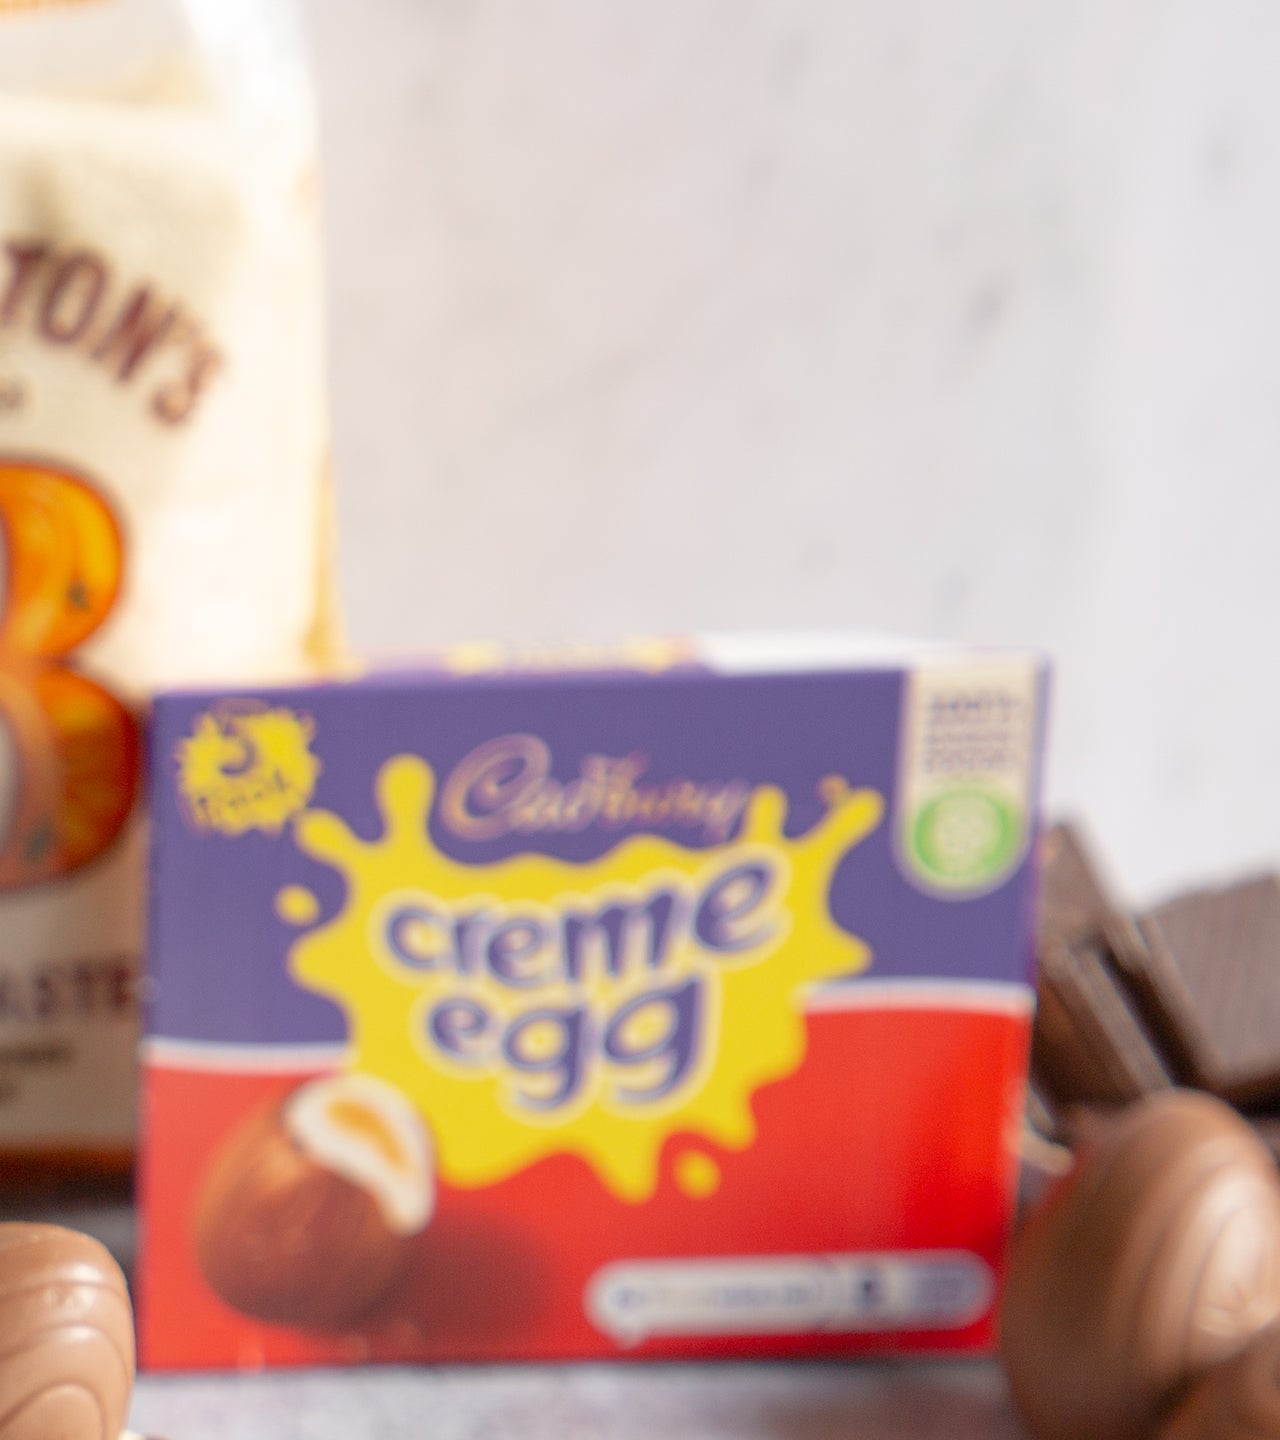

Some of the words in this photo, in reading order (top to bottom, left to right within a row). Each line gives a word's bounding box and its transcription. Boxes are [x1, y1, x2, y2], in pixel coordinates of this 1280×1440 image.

[443, 733, 746, 842] Cadbury
[385, 862, 783, 987] creme
[427, 975, 702, 1110] egg
